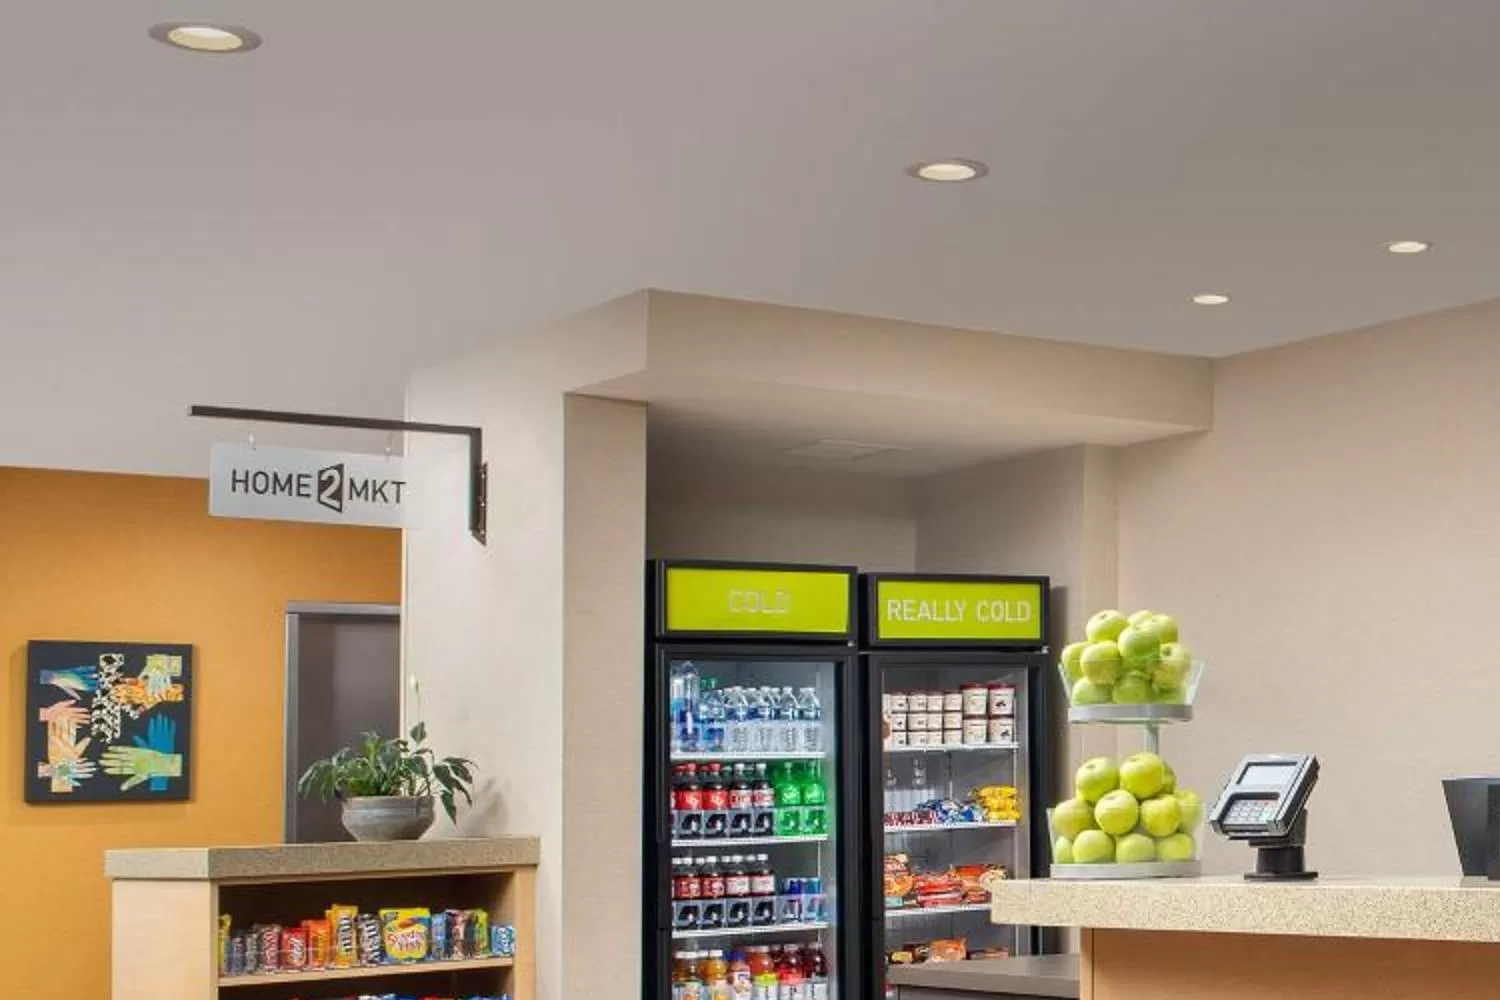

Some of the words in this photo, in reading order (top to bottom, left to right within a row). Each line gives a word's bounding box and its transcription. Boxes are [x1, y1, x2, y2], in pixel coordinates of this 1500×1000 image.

[349, 479, 407, 504] MKT
[727, 588, 792, 615] COLD
[886, 599, 966, 622] REALLY
[975, 600, 1032, 623] COLD
